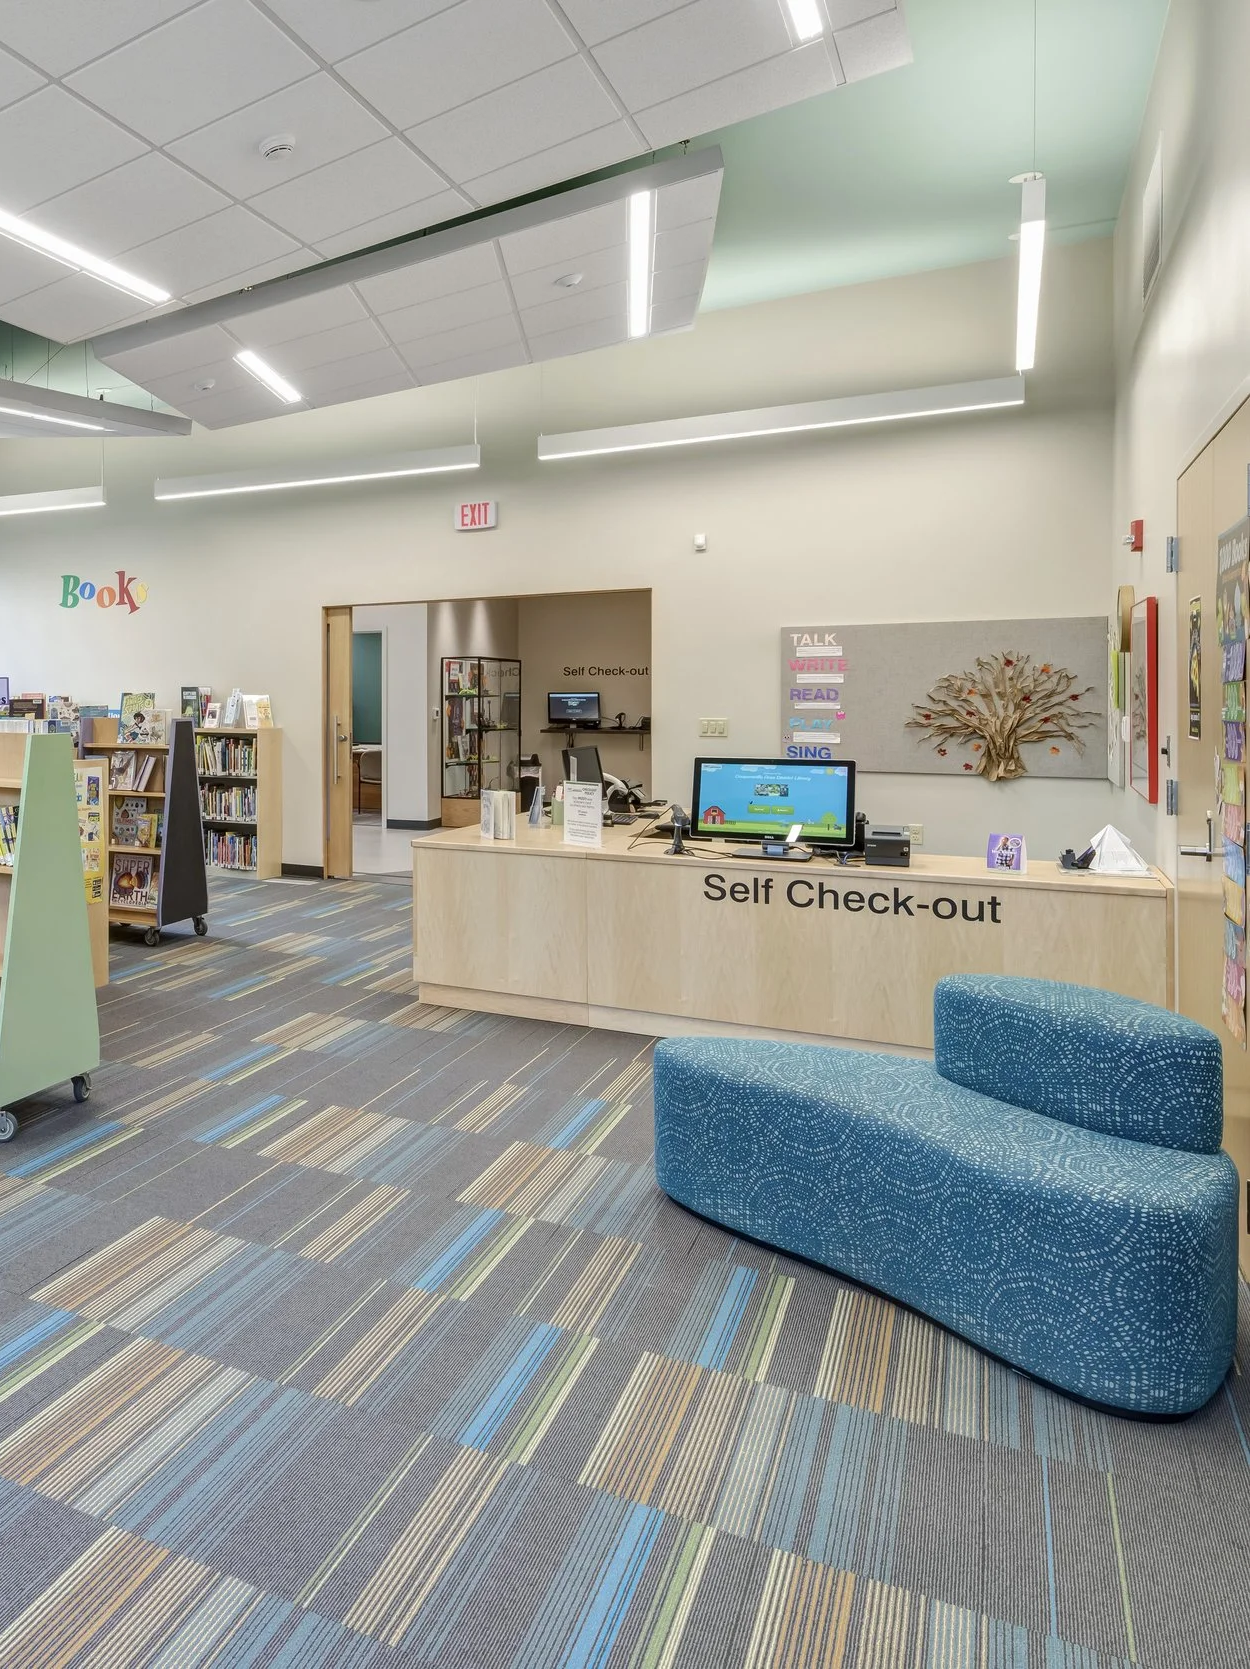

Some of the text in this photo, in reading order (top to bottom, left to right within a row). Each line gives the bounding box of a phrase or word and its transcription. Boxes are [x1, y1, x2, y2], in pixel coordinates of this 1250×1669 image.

[461, 502, 490, 527] EXIT
[59, 571, 149, 615] Books
[790, 633, 837, 646] TALK
[563, 666, 649, 677] Self Check-out
[787, 658, 848, 672] WRITE
[790, 688, 839, 701] READ
[789, 717, 834, 730] PLAY
[786, 746, 832, 759] SING
[115, 858, 150, 875] SUPER
[111, 890, 149, 901] EARTH
[704, 874, 1002, 924] Self Check-out
